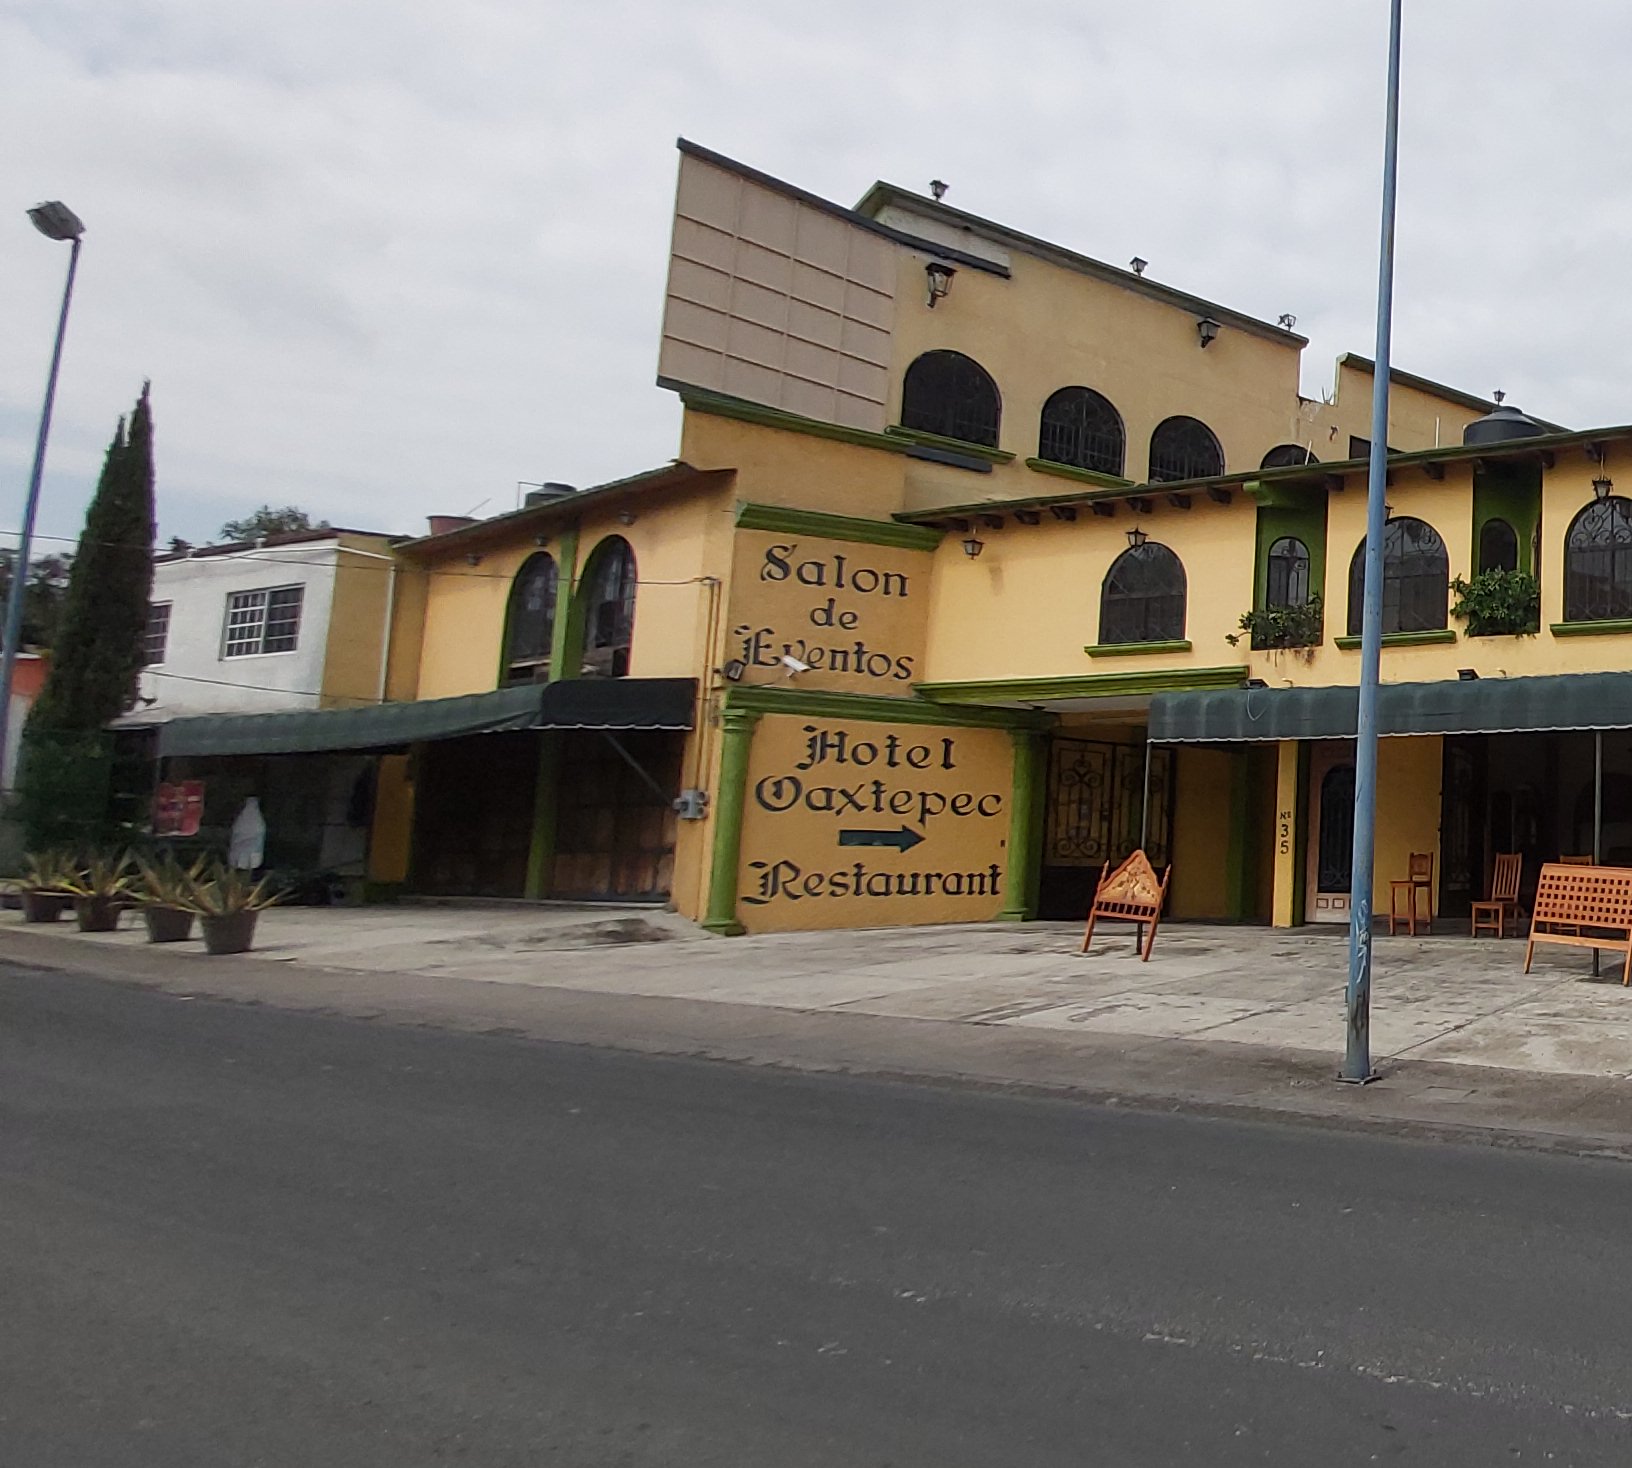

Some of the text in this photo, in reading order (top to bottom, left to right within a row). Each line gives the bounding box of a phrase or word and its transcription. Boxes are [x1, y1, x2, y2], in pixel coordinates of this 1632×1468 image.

[760, 544, 910, 597] Salon
[810, 597, 858, 630] de
[734, 625, 914, 680] Eventos
[795, 724, 957, 770] Hotel
[755, 775, 1003, 828] Oaxtepec
[741, 859, 1003, 905] Restaurant
